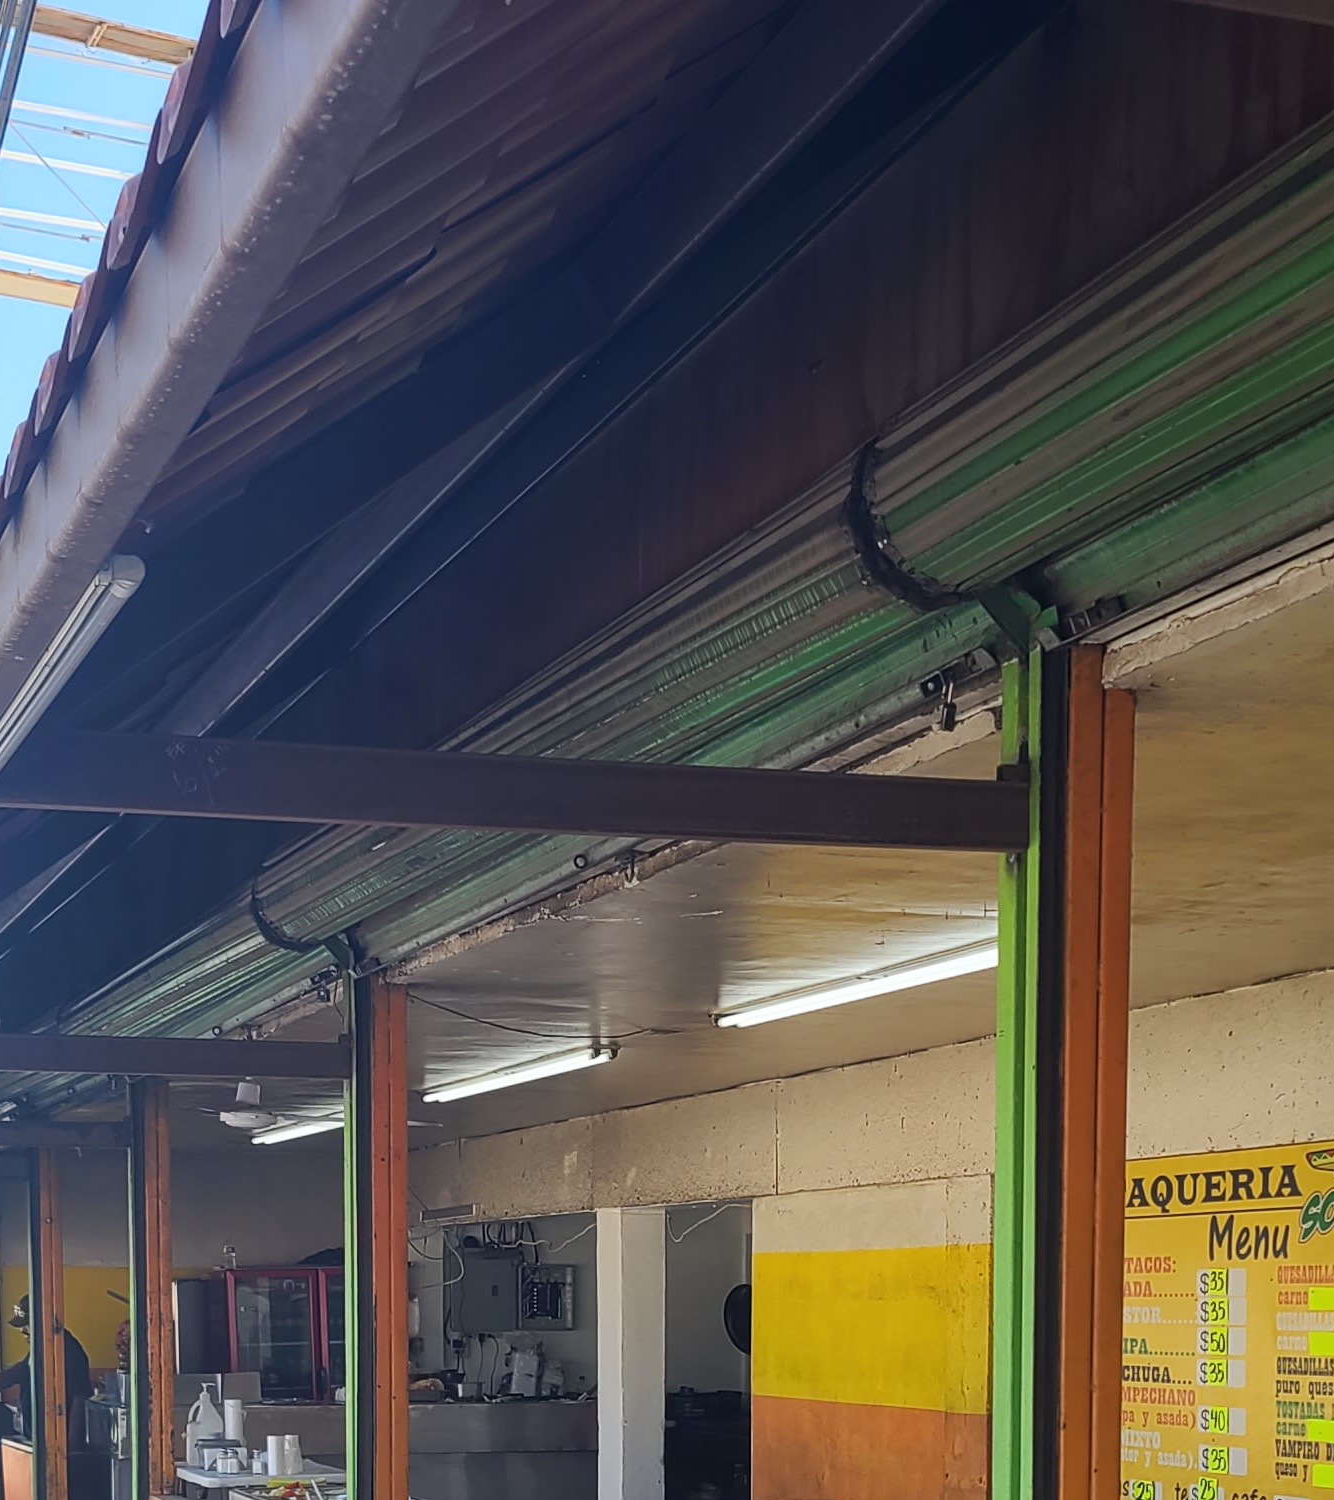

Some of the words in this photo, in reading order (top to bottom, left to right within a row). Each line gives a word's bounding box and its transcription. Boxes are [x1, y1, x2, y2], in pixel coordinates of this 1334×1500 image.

[1126, 1165, 1303, 1213] AQUERIA
[1209, 1215, 1289, 1261] Menu
[1124, 1256, 1176, 1273] TACOS:
[1199, 1271, 1224, 1295] $35
[1277, 1291, 1308, 1305] carne
[1200, 1300, 1225, 1323] $35
[1276, 1311, 1334, 1332] QUESADILLAS
[1200, 1330, 1225, 1353] $50
[1276, 1336, 1307, 1350] carne
[1199, 1362, 1224, 1385] $35
[1276, 1356, 1334, 1377] QUESADILLAS
[1122, 1386, 1196, 1407] MPECHANO
[1275, 1379, 1300, 1398] puro
[1122, 1410, 1135, 1425] pa
[1142, 1411, 1149, 1427] y
[1156, 1410, 1196, 1430] asada)
[1201, 1409, 1225, 1431] $40
[1275, 1400, 1325, 1420] TOSTADAS
[1276, 1421, 1306, 1437] carne
[1121, 1447, 1139, 1462] stor
[1144, 1450, 1151, 1467] y
[1201, 1448, 1226, 1471] $35
[1275, 1438, 1320, 1460] VAMPIRO
[1275, 1461, 1297, 1479] queso
[1302, 1465, 1308, 1482] y
